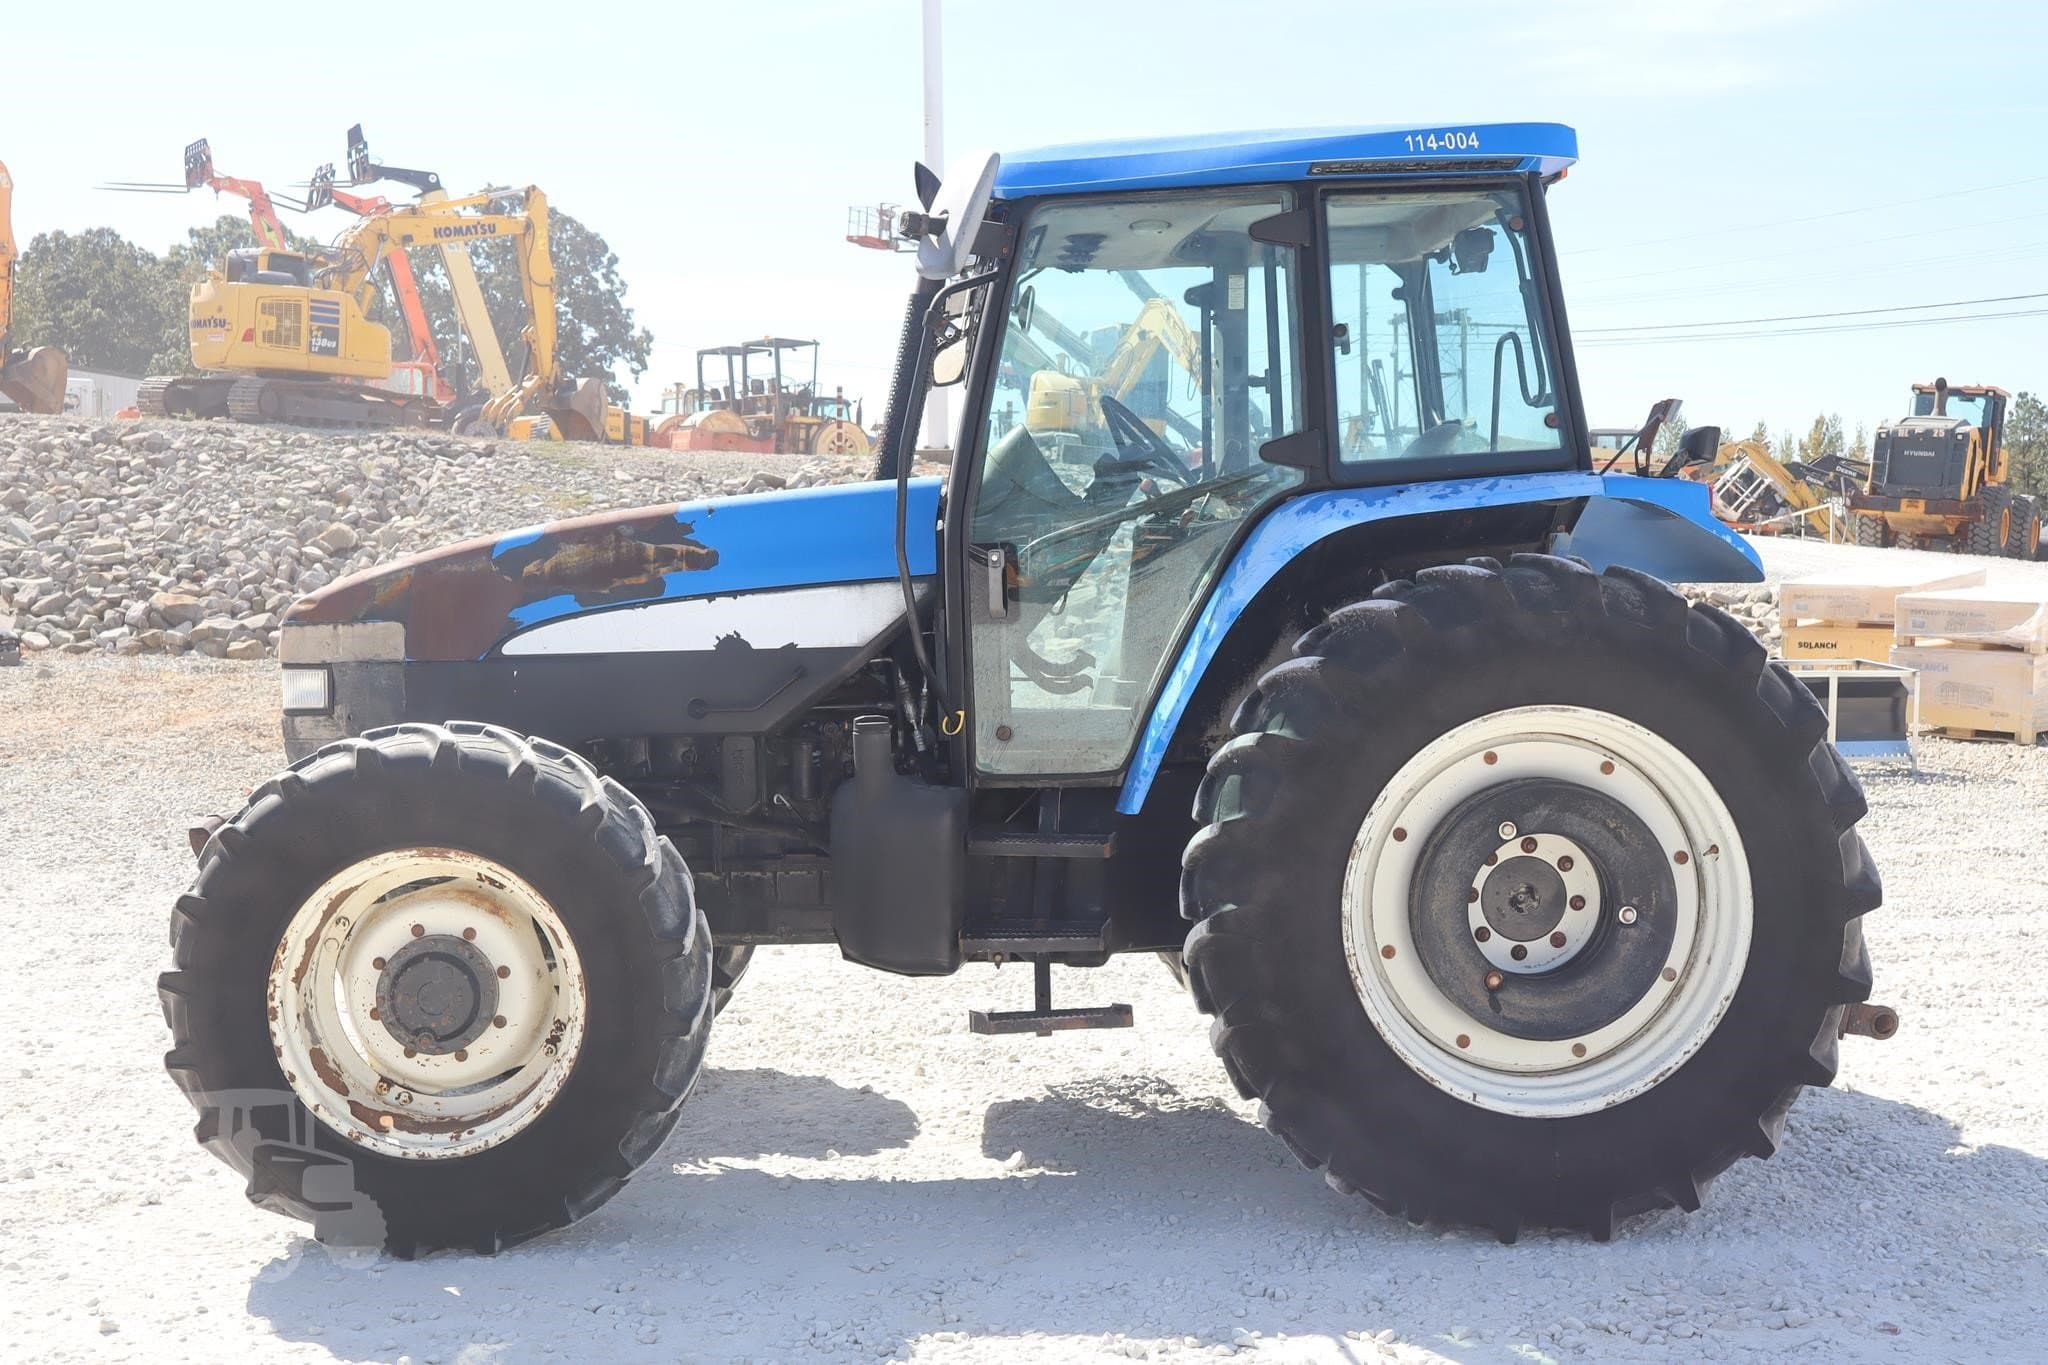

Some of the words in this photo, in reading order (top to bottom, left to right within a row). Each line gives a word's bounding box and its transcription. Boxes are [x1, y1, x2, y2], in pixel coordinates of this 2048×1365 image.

[1404, 131, 1479, 152] 114-004
[433, 221, 496, 238] KOMATSU
[190, 316, 226, 329] OMATSU
[1903, 449, 1935, 457] HYUNDAI
[1835, 465, 1857, 477] DEERE
[1797, 641, 1837, 649] SOLANCH
